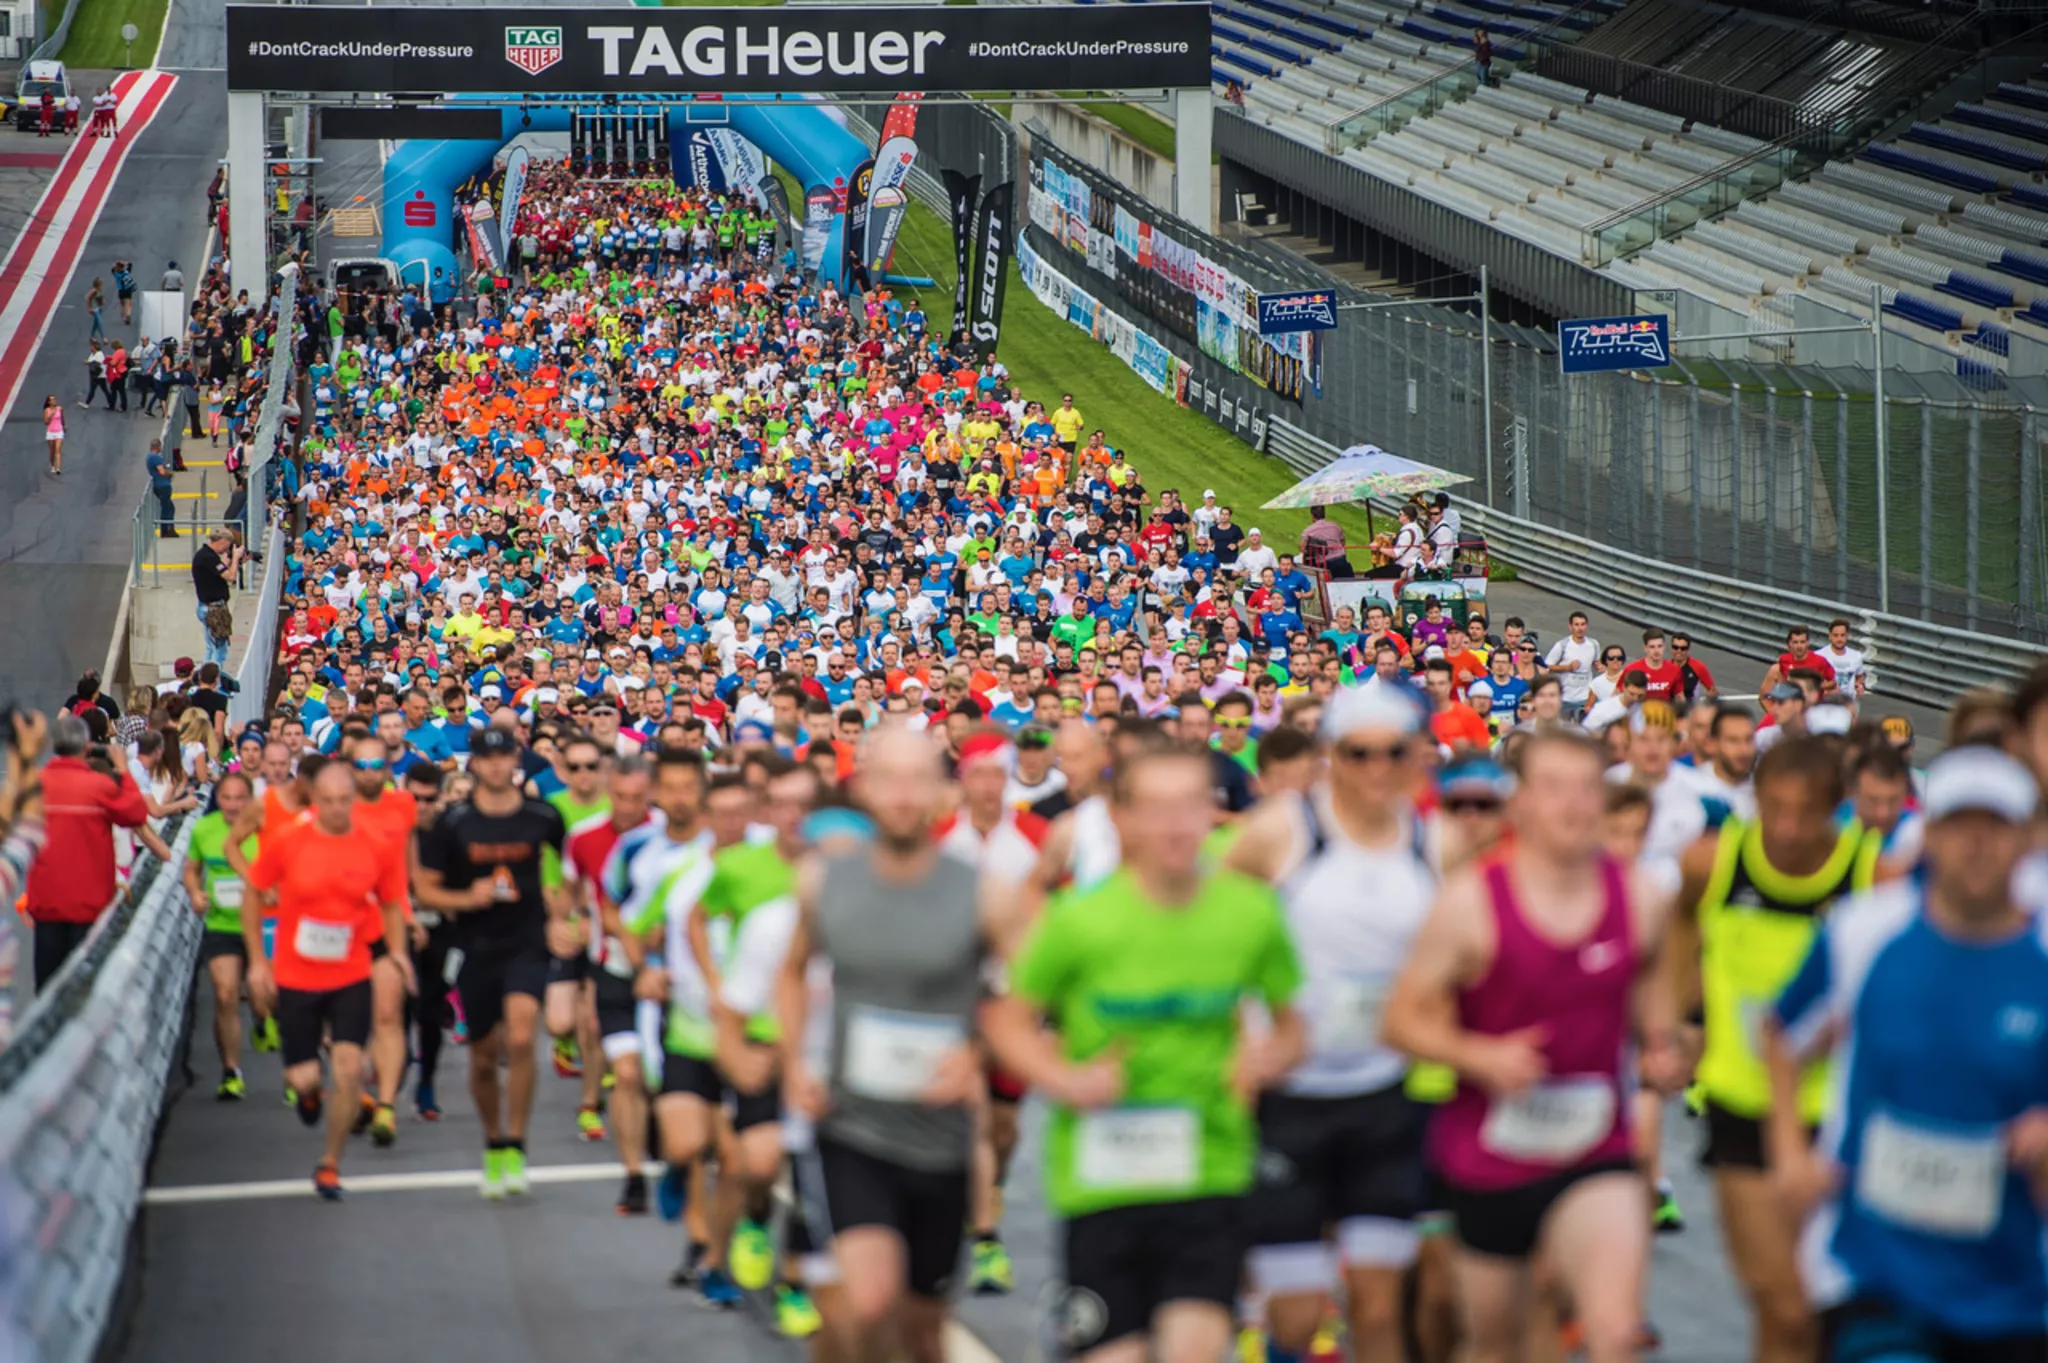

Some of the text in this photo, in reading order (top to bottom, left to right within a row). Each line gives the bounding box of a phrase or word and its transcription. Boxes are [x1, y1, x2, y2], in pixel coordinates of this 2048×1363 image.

[510, 30, 556, 44] TAG
[246, 41, 475, 58] #DontCrackUnderPressure
[967, 40, 1189, 57] #DontCrackUnderPressure
[510, 49, 558, 70] HEUER
[981, 209, 1002, 319] SCOTT
